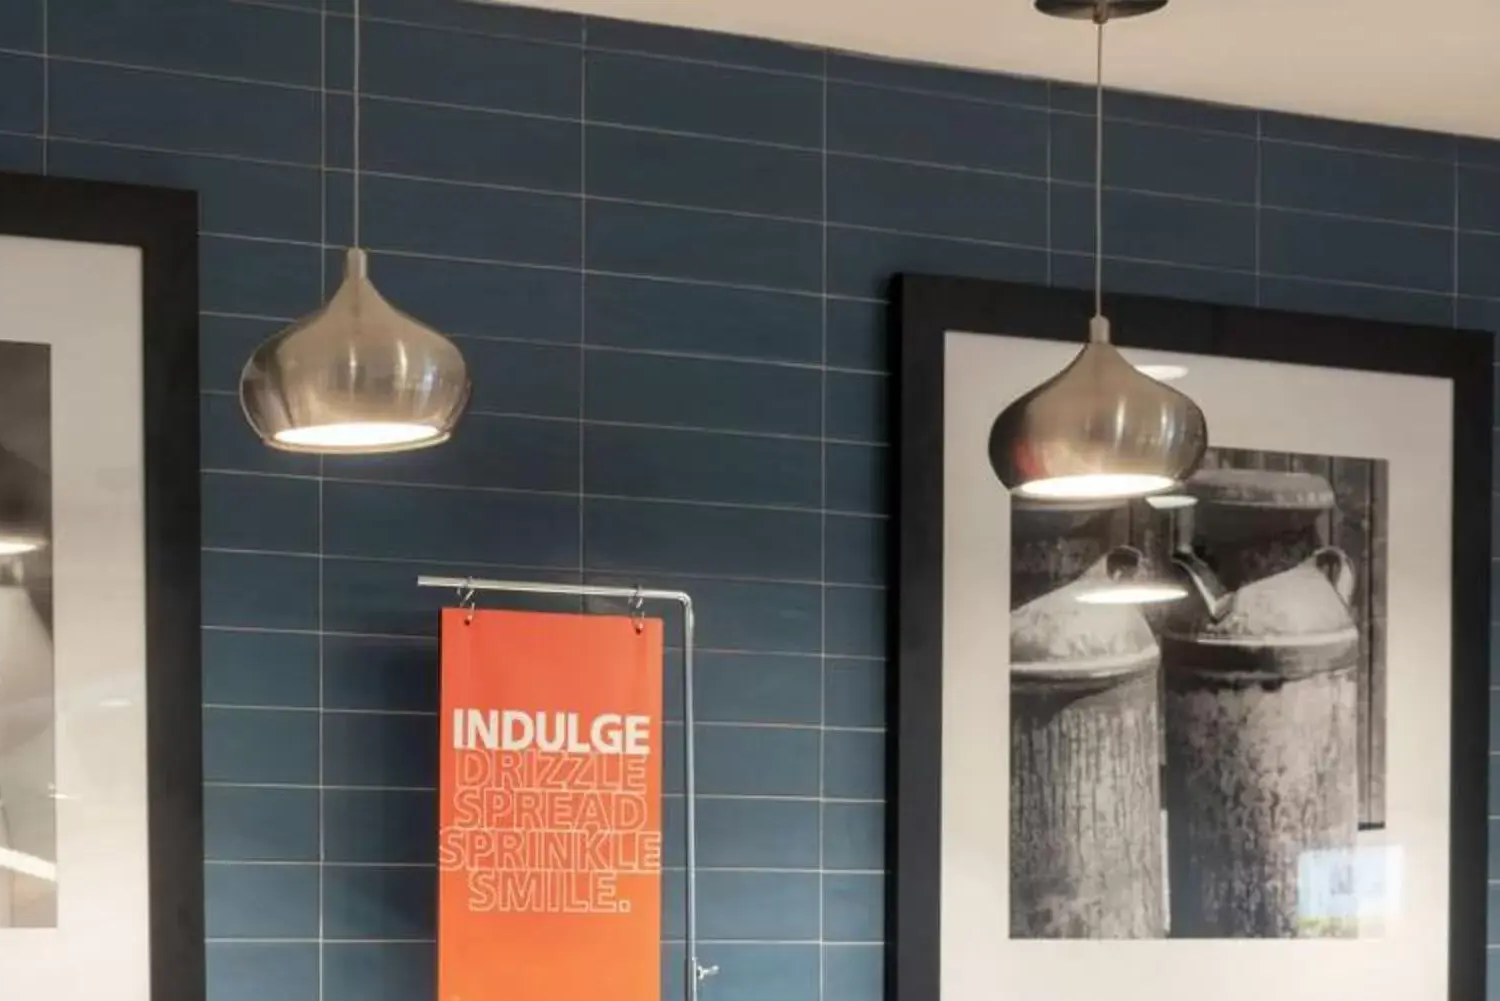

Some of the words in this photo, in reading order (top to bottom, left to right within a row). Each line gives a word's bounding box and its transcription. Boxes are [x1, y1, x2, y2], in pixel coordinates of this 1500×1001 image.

[453, 709, 651, 754] INDULGE
[455, 749, 647, 793] DRIZZLE
[453, 787, 648, 832] SPREAD
[438, 827, 661, 874] SPRINKLE
[468, 871, 632, 914] SMILE.
